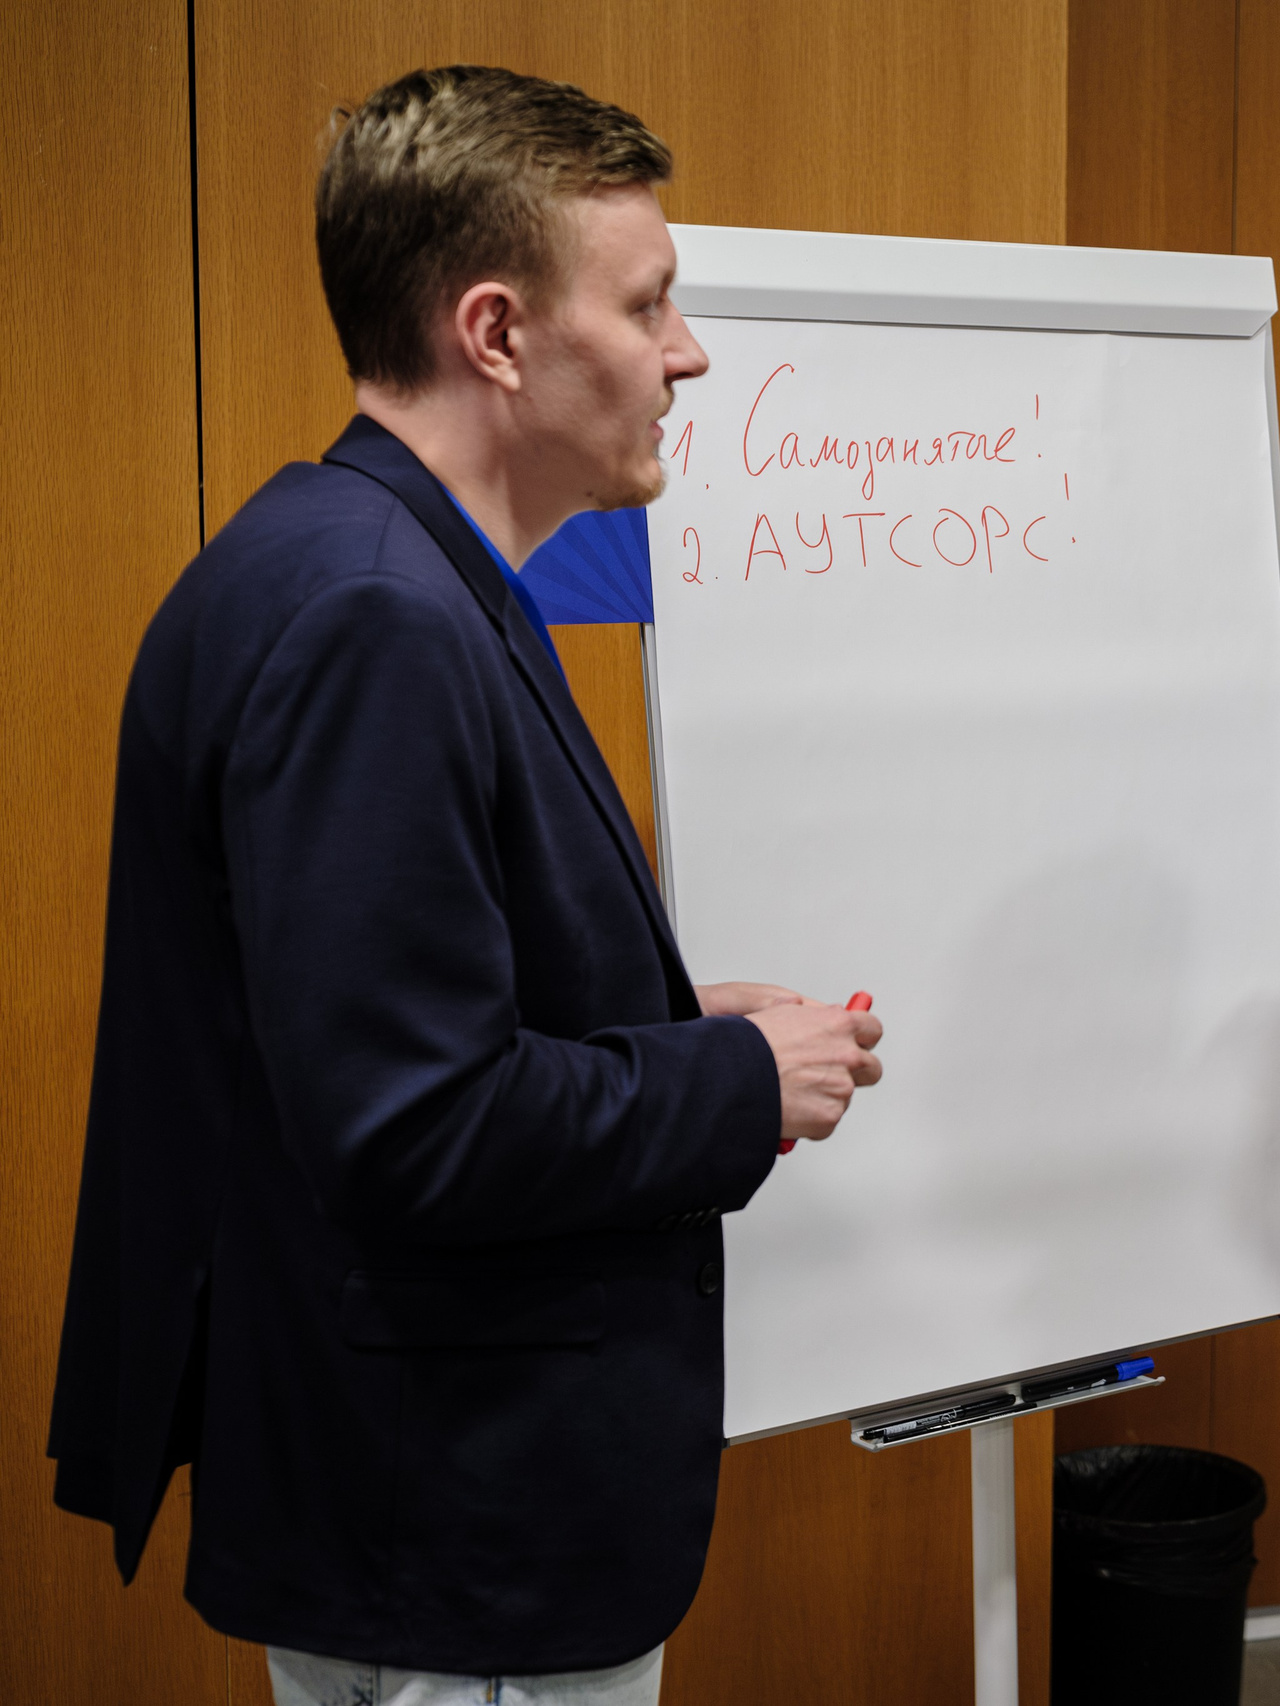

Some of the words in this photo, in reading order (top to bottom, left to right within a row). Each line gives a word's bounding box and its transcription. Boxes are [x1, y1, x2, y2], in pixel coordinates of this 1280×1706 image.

[670, 420, 711, 490] 1.
[682, 526, 719, 585] 2.
[745, 473, 1077, 581] АУТСОРС!
